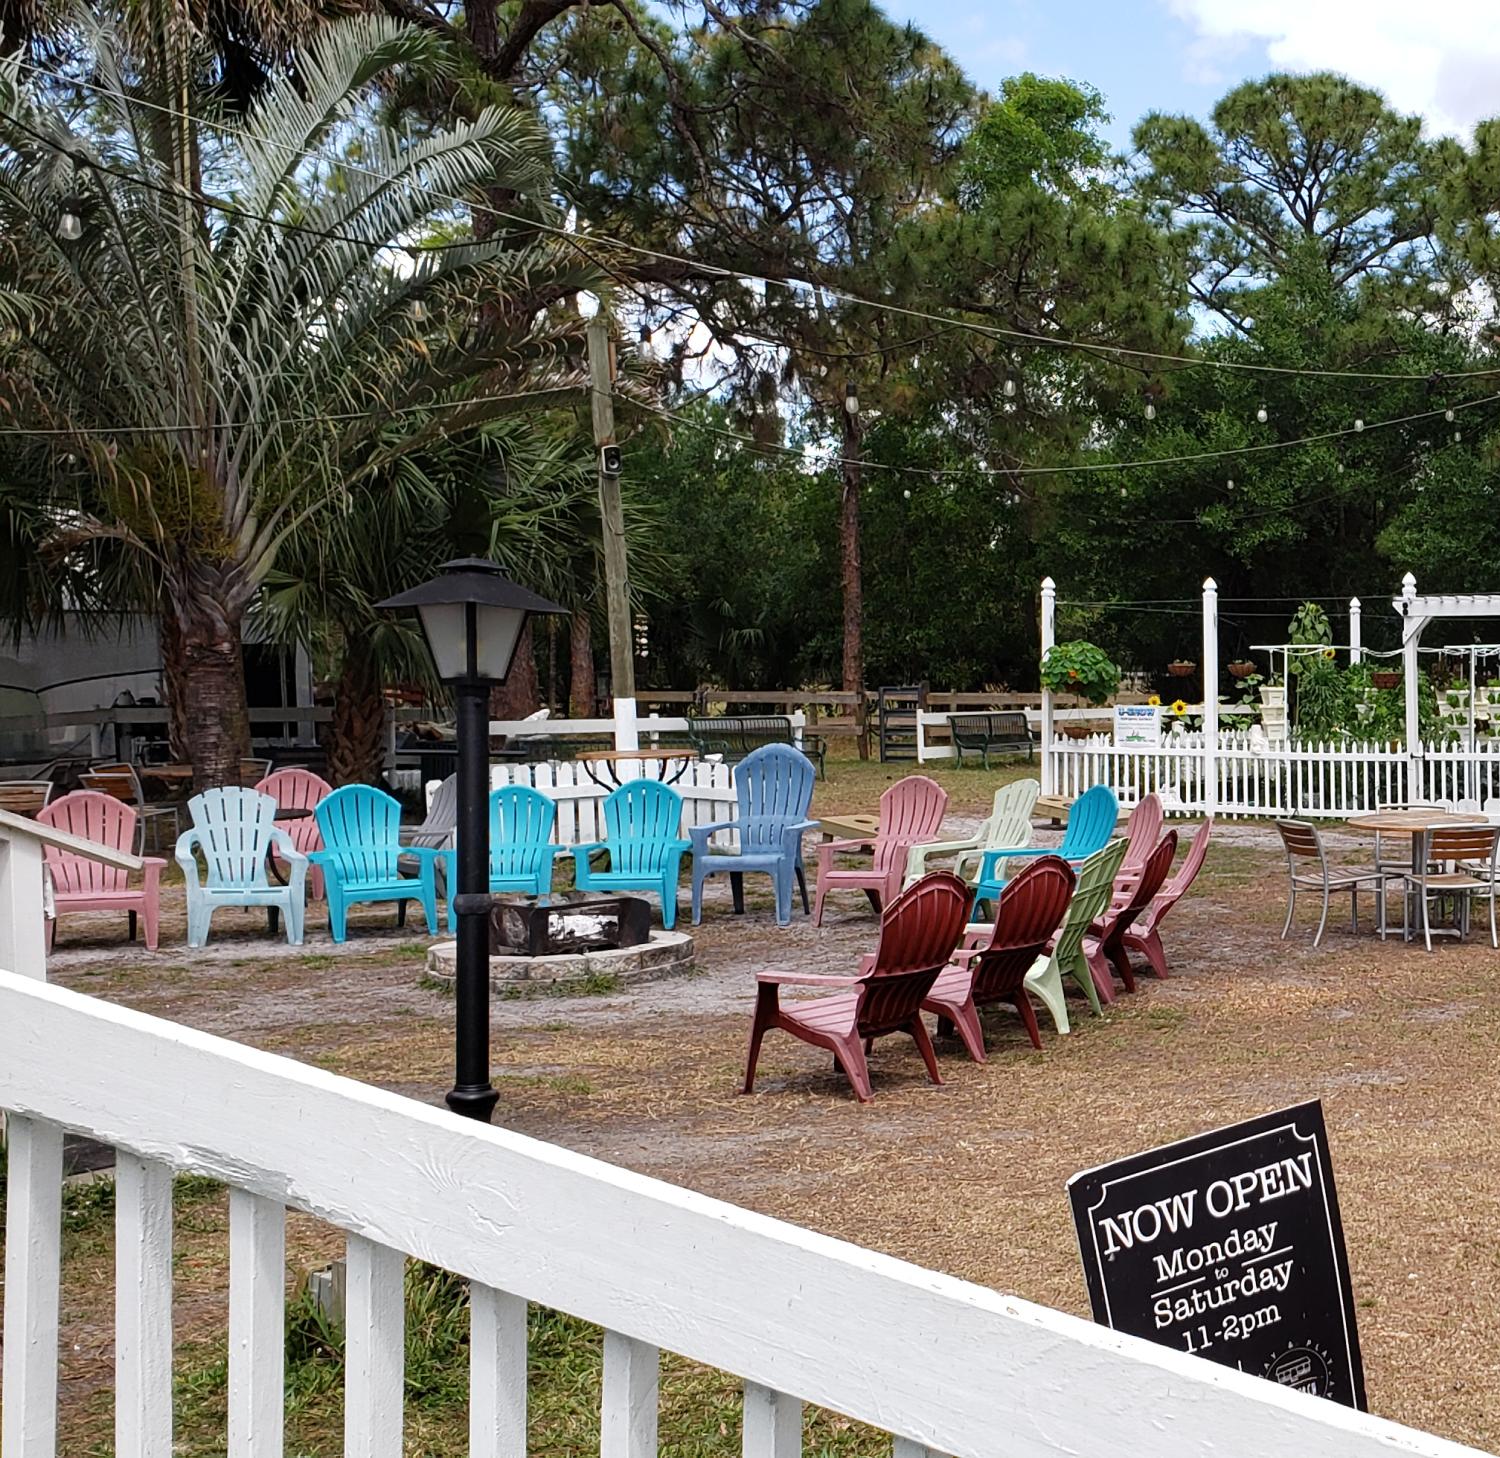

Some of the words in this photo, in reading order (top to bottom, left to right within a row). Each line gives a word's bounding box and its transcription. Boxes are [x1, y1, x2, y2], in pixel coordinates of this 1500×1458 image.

[1099, 1189, 1198, 1256] NOW
[1205, 1151, 1313, 1219] OPEN
[1152, 1221, 1279, 1284] Monday
[1214, 1266, 1229, 1281] to
[1153, 1259, 1294, 1330] Saturday
[1182, 1303, 1282, 1354] 11-2pm
